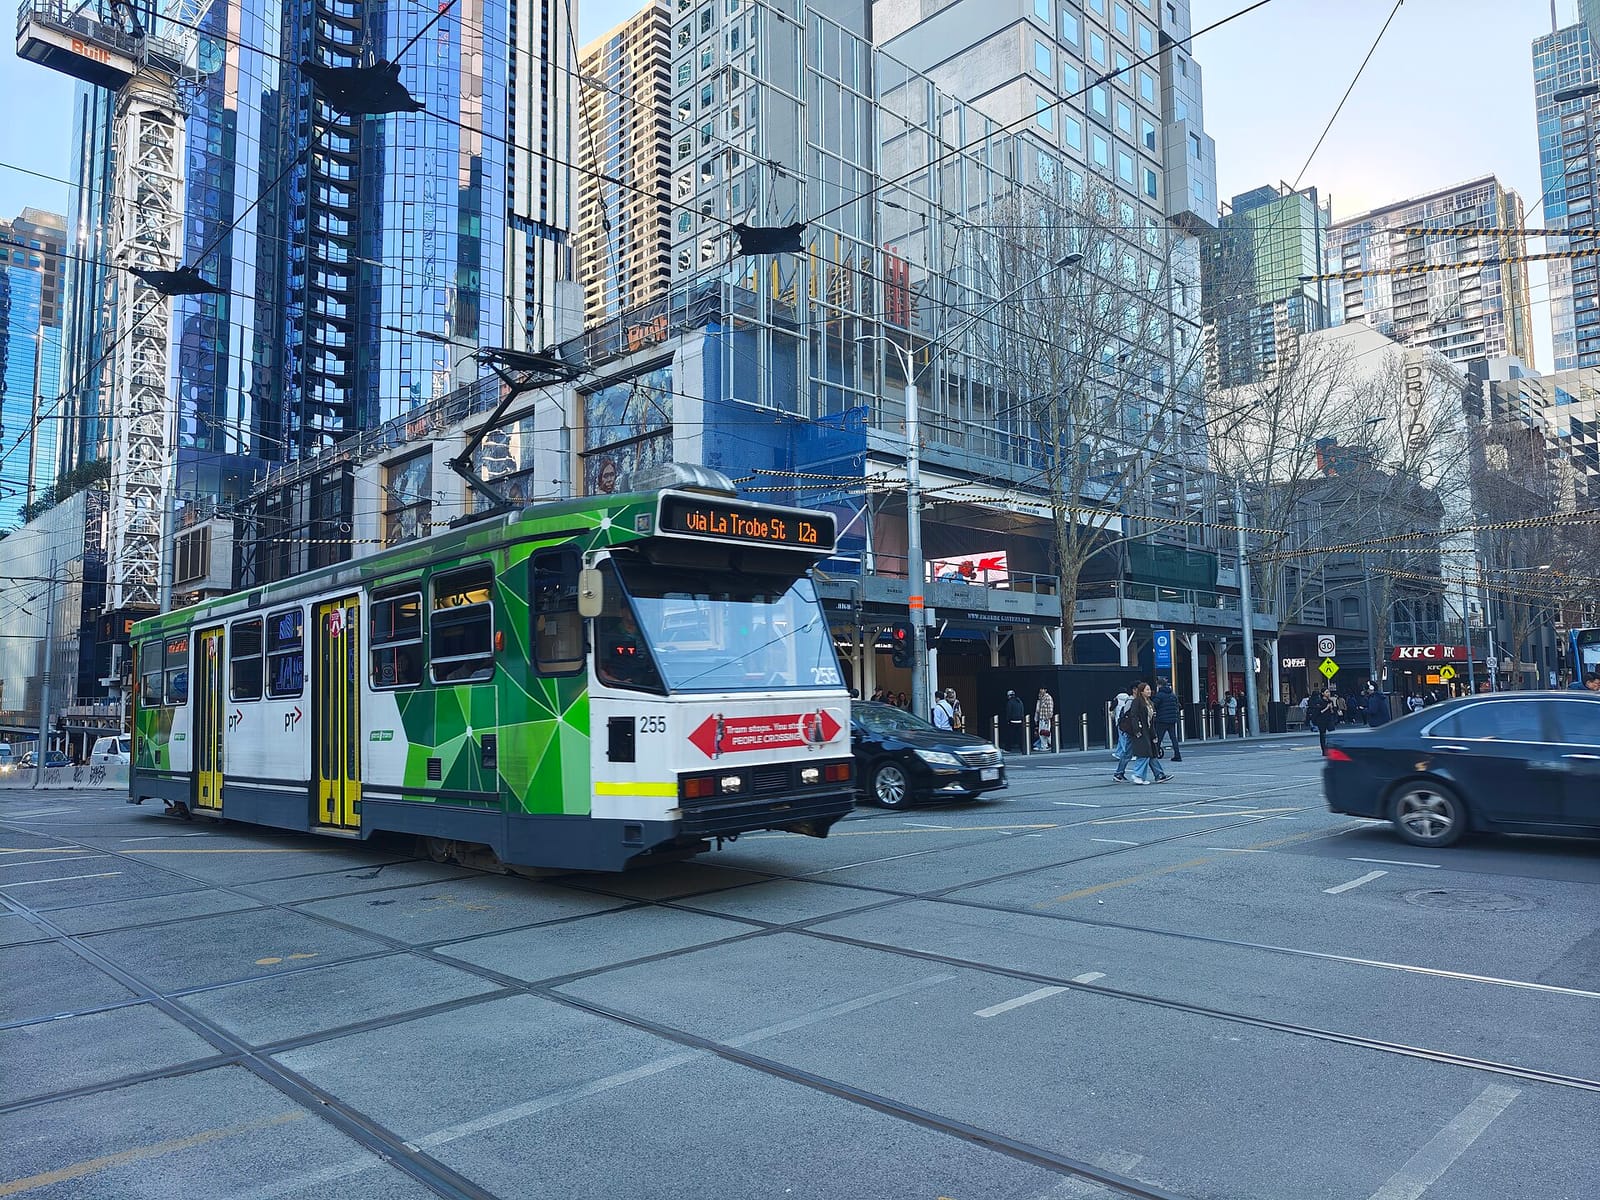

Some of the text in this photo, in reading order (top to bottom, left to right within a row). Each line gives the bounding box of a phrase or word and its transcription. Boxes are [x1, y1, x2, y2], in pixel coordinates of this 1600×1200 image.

[72, 39, 111, 63] Built
[686, 511, 817, 543] via La Trobe St 12a
[1321, 642, 1332, 650] 30
[1399, 646, 1436, 658] KFC
[1443, 646, 1455, 658] KFC
[810, 667, 842, 685] 255
[640, 716, 666, 733] 255
[726, 726, 748, 734] Tram
[773, 723, 788, 731] You
[732, 732, 801, 745] PEOPLE CROSSING
